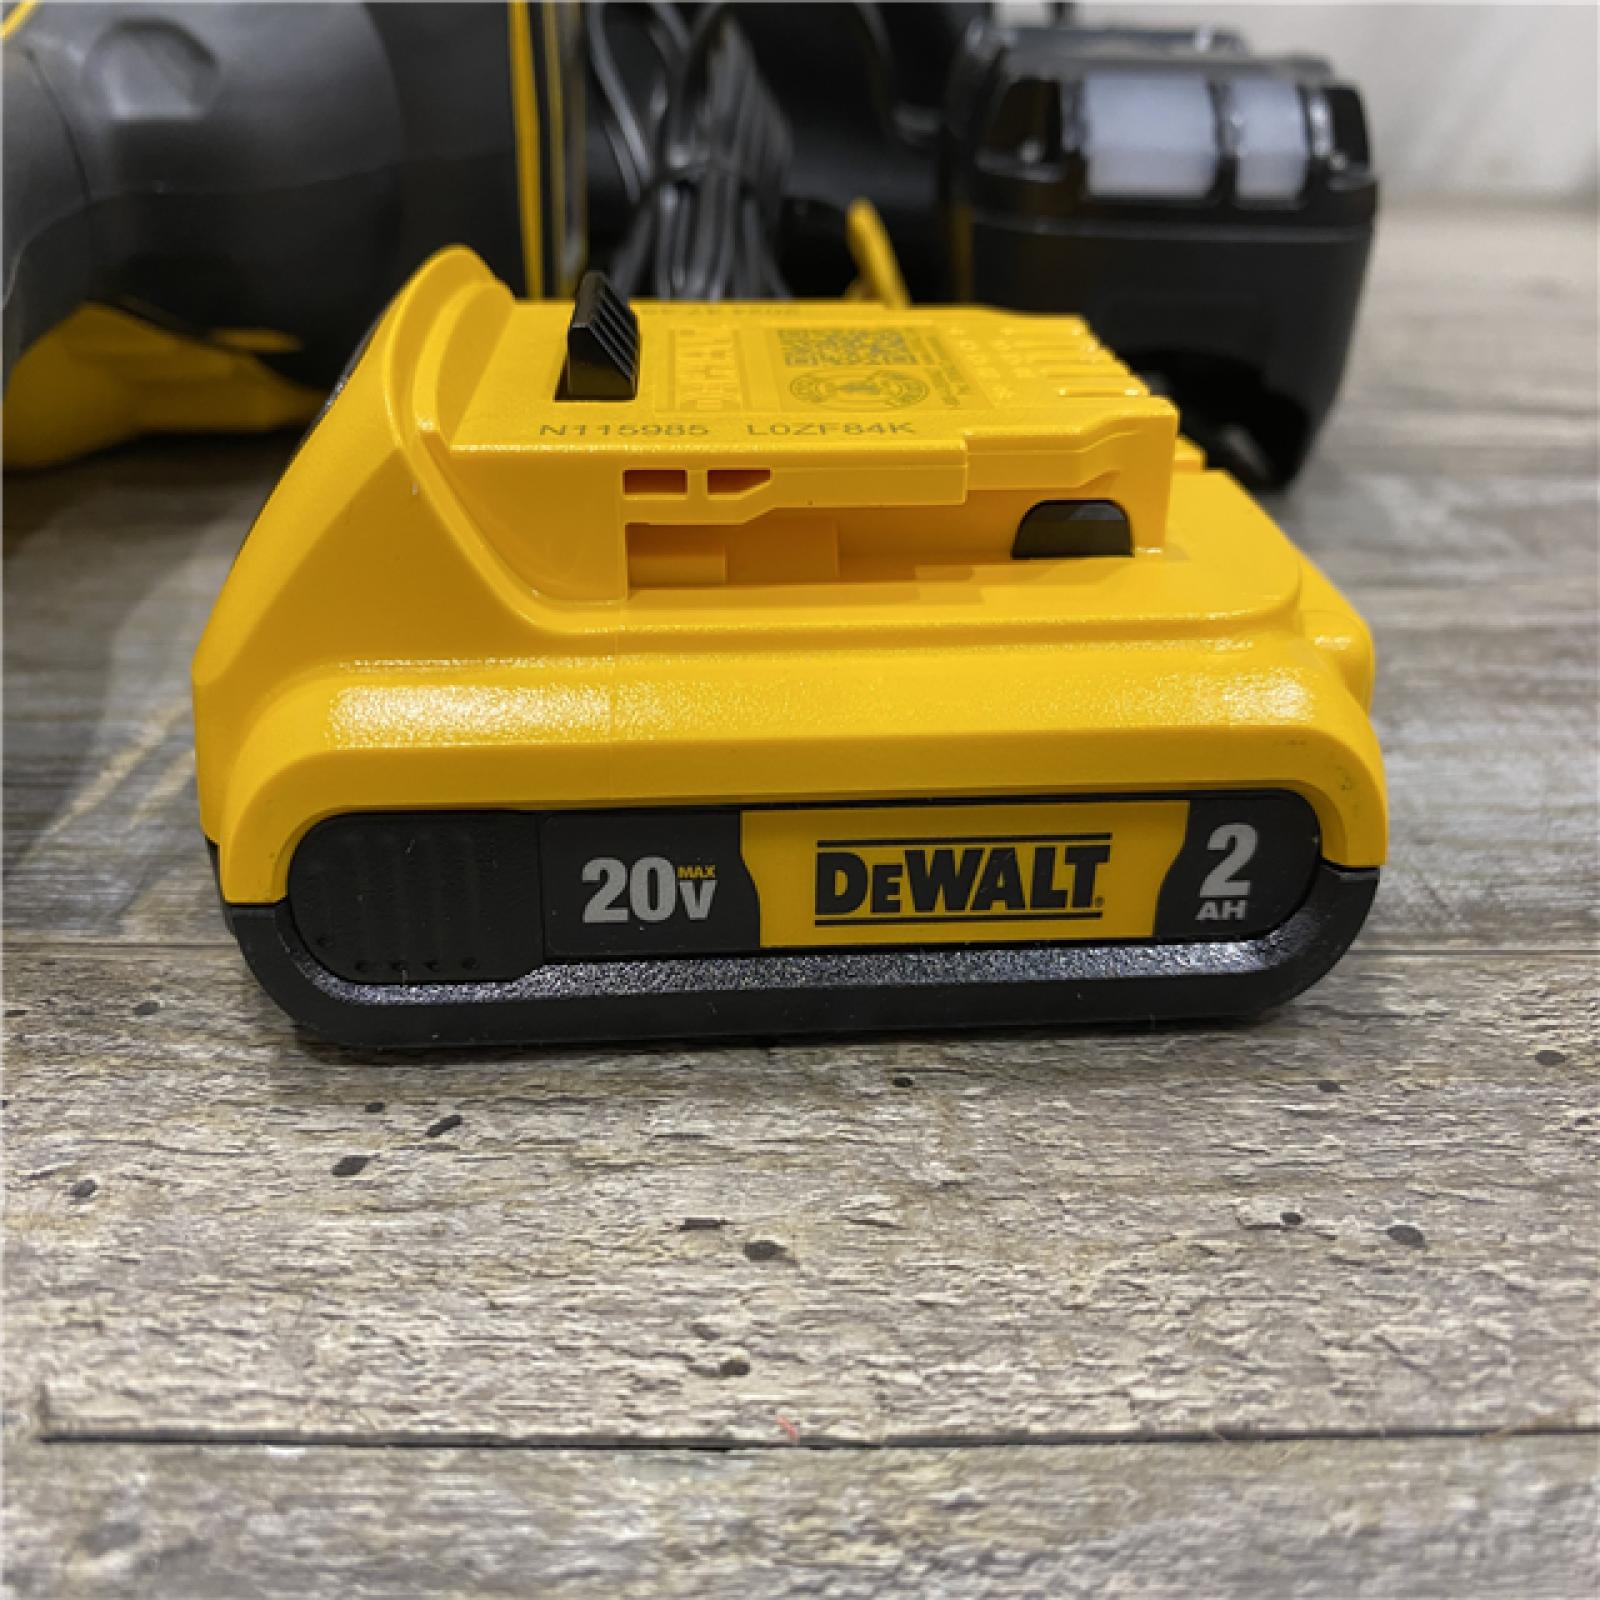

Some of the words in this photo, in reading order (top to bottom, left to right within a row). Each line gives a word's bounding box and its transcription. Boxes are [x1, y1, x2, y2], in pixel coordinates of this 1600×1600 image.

[539, 424, 710, 437] N115985
[1199, 822, 1258, 898] 2
[676, 864, 717, 879] MAX
[1195, 900, 1247, 921] AH
